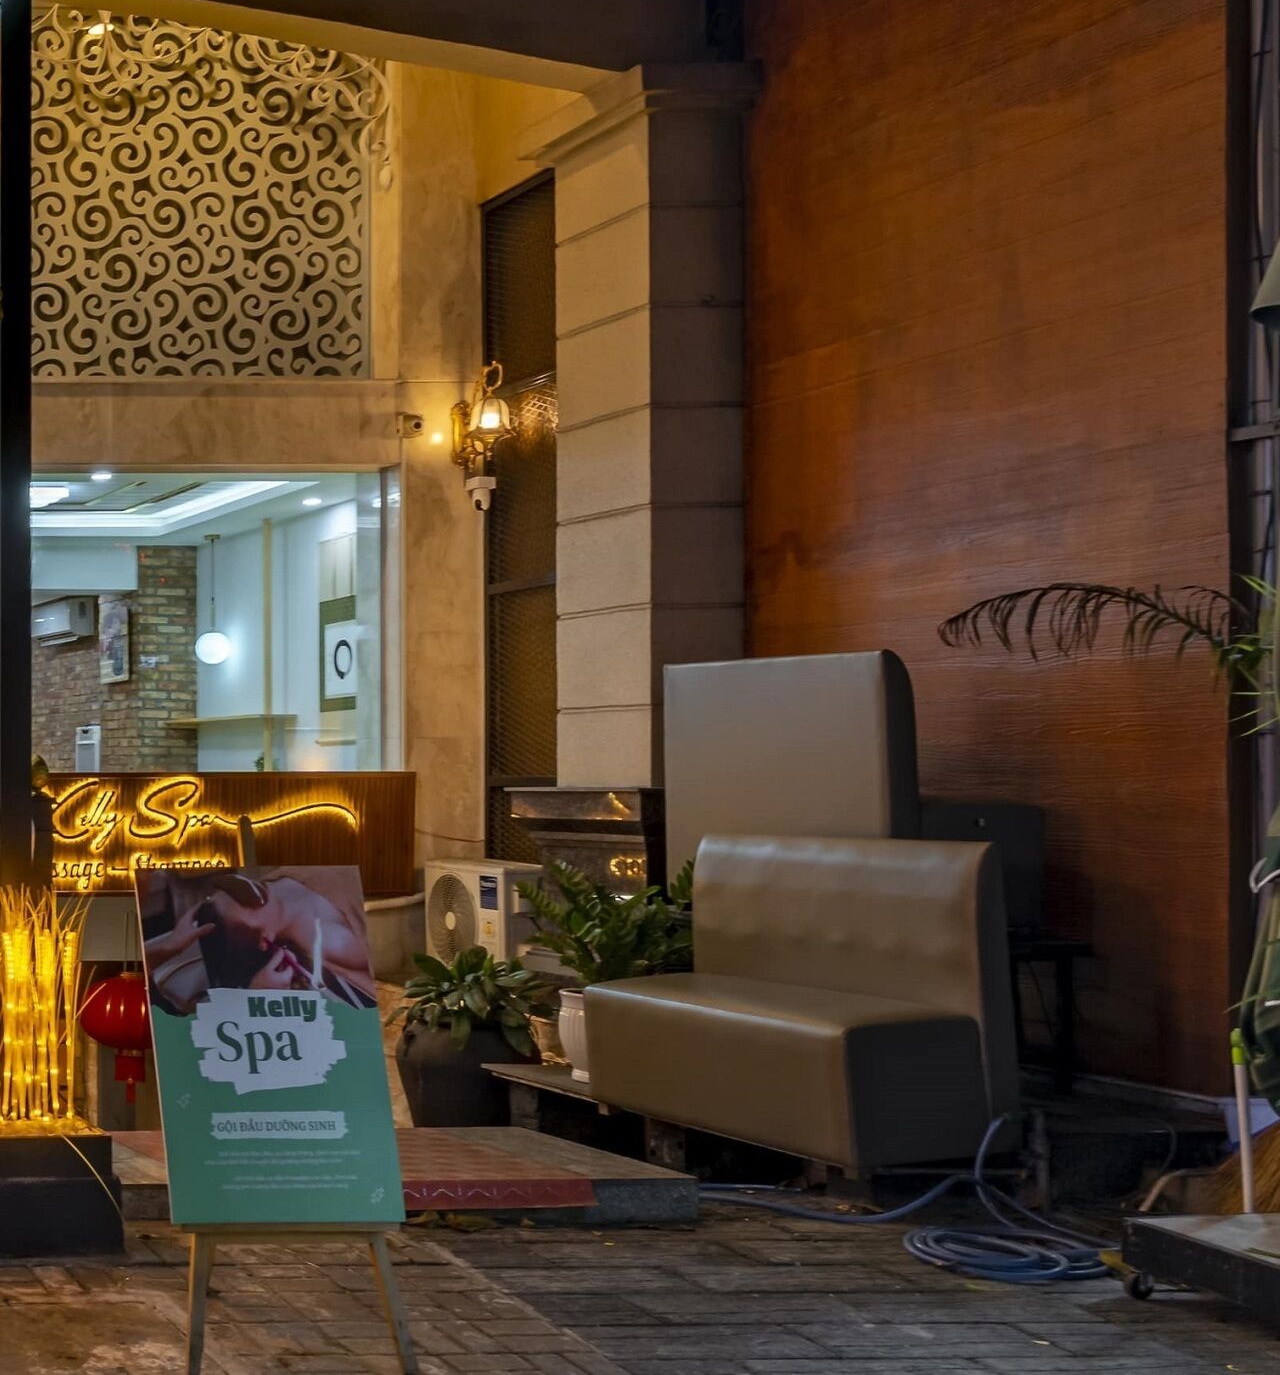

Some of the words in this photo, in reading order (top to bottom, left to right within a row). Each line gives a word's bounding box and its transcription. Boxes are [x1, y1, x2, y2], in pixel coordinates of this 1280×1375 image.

[129, 780, 217, 845] Spa
[247, 996, 318, 1023] Kelly
[215, 1019, 304, 1075] Spa
[308, 1120, 337, 1132] SINH
